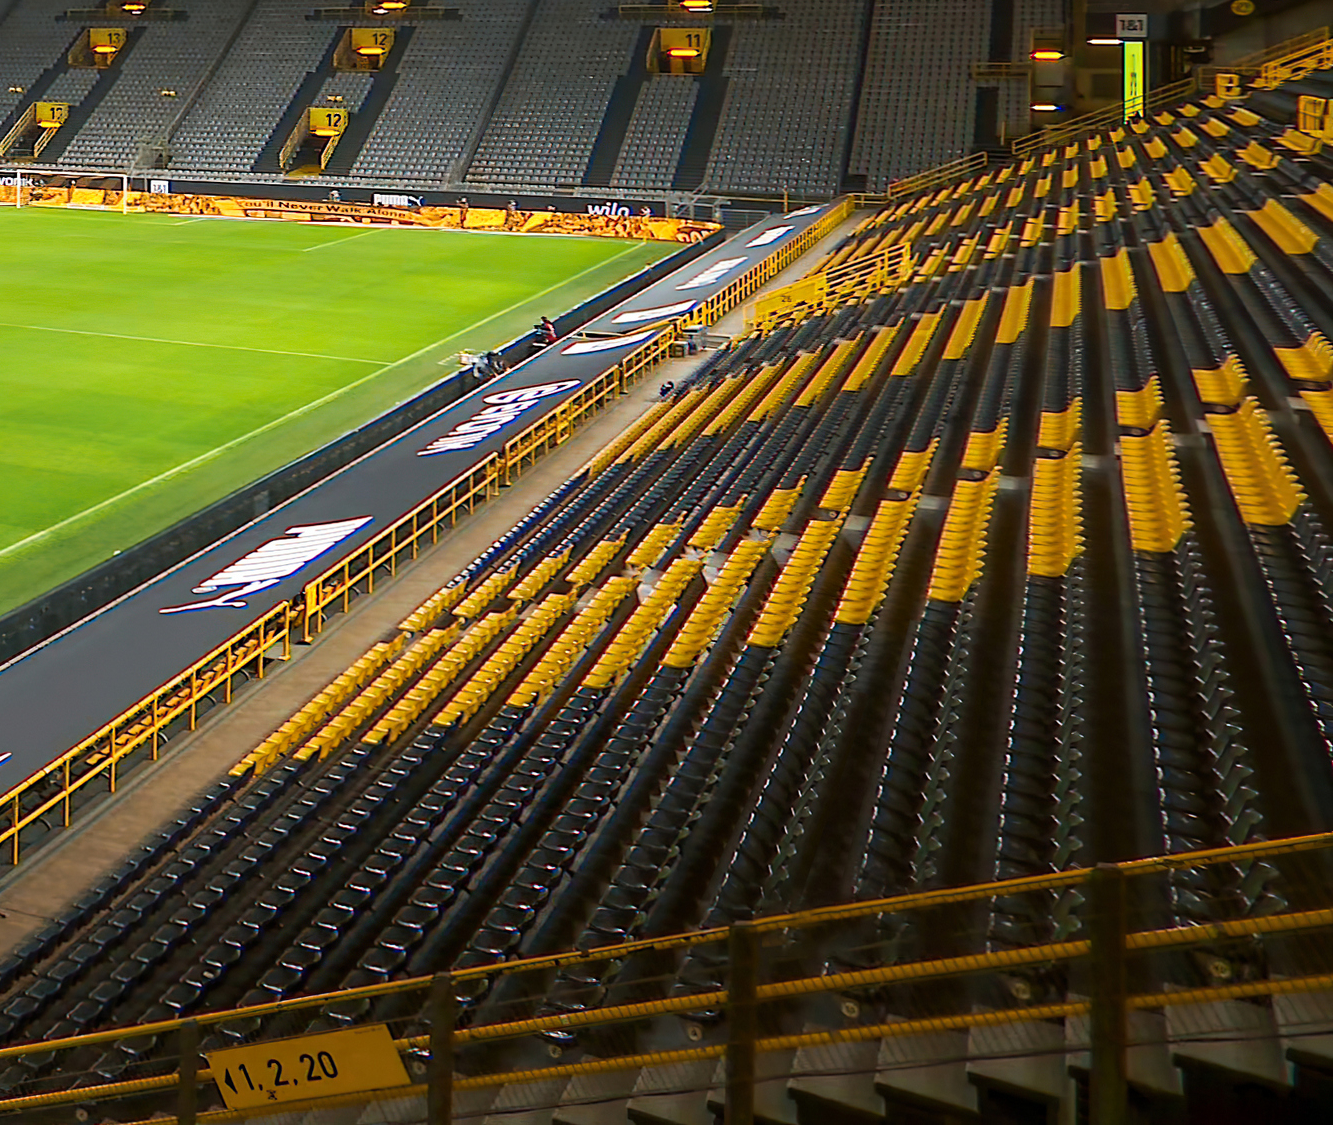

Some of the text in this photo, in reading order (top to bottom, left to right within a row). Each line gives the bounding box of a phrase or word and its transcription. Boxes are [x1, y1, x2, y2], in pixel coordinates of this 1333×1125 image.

[107, 33, 121, 44] 13
[372, 33, 387, 45] 12
[686, 35, 700, 47] 11
[325, 114, 341, 127] 12
